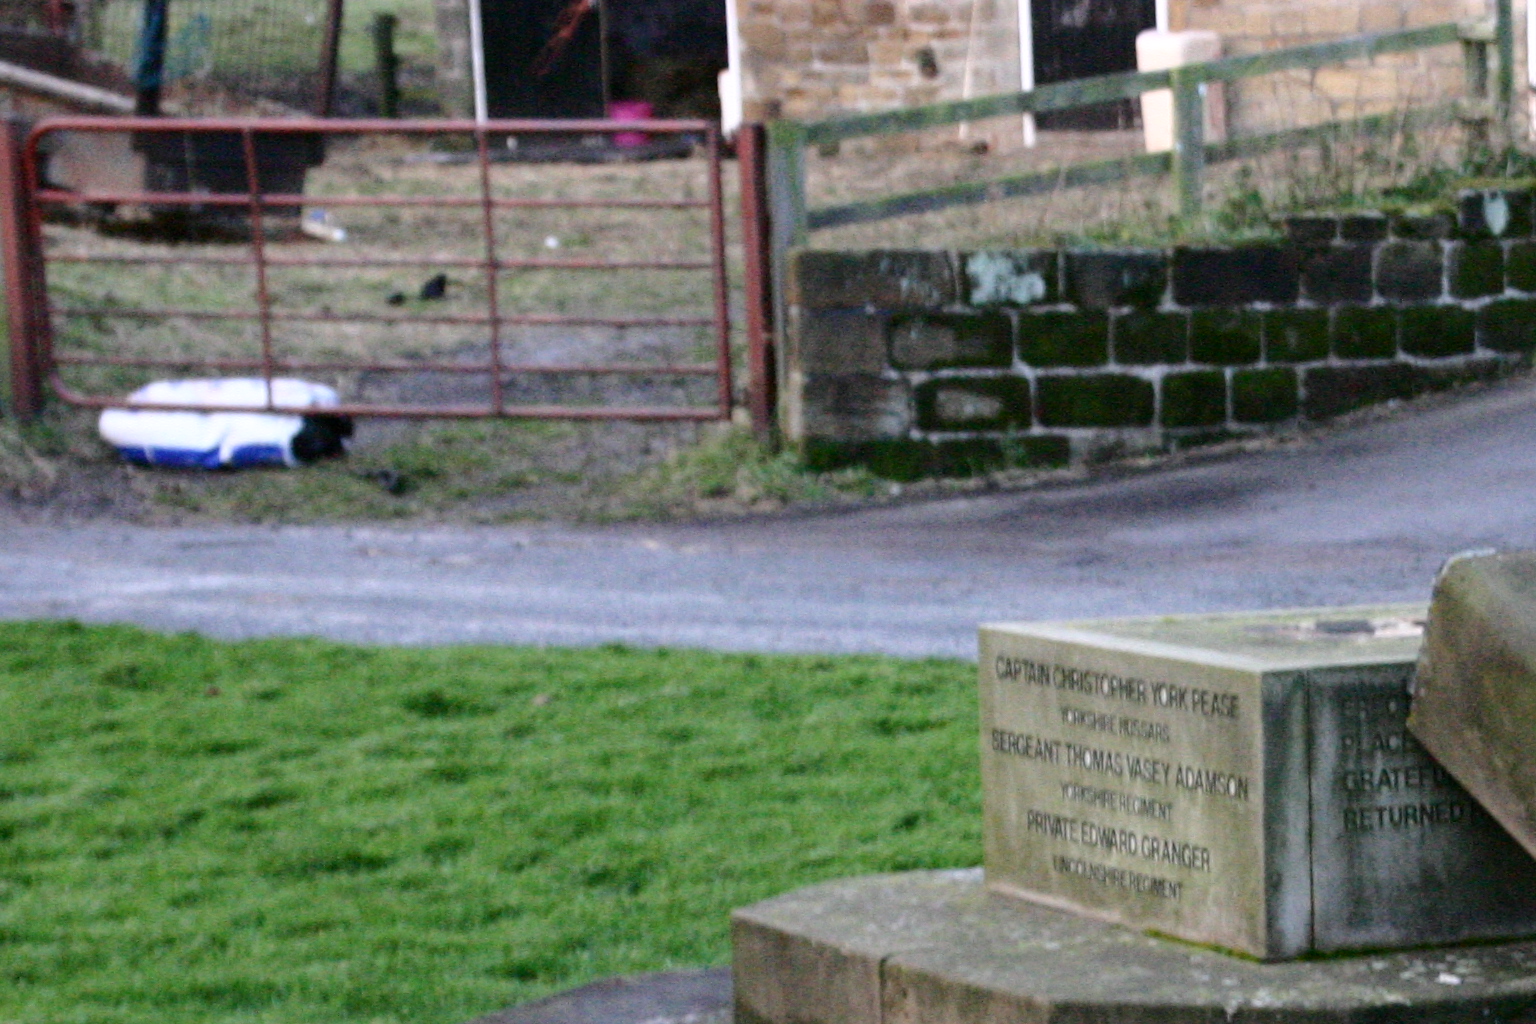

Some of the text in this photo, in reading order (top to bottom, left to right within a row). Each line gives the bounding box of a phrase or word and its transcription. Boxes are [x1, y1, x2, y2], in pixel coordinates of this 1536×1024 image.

[996, 655, 1239, 719] CAPTAIN CHRISTOPHER YORK PEASE
[1061, 706, 1170, 743] YORKSHIRE HUSSARS
[992, 728, 1249, 802] SERGEANT THOMAS VASEY ADAMSON
[1061, 782, 1173, 822] YORKSHIRE REGIMENT
[1343, 801, 1463, 830] RETURNED
[1027, 810, 1211, 873] PRIVATE EDWARD GRANGER
[1053, 855, 1183, 900] LINCOLNSHIRE REGIMENT
